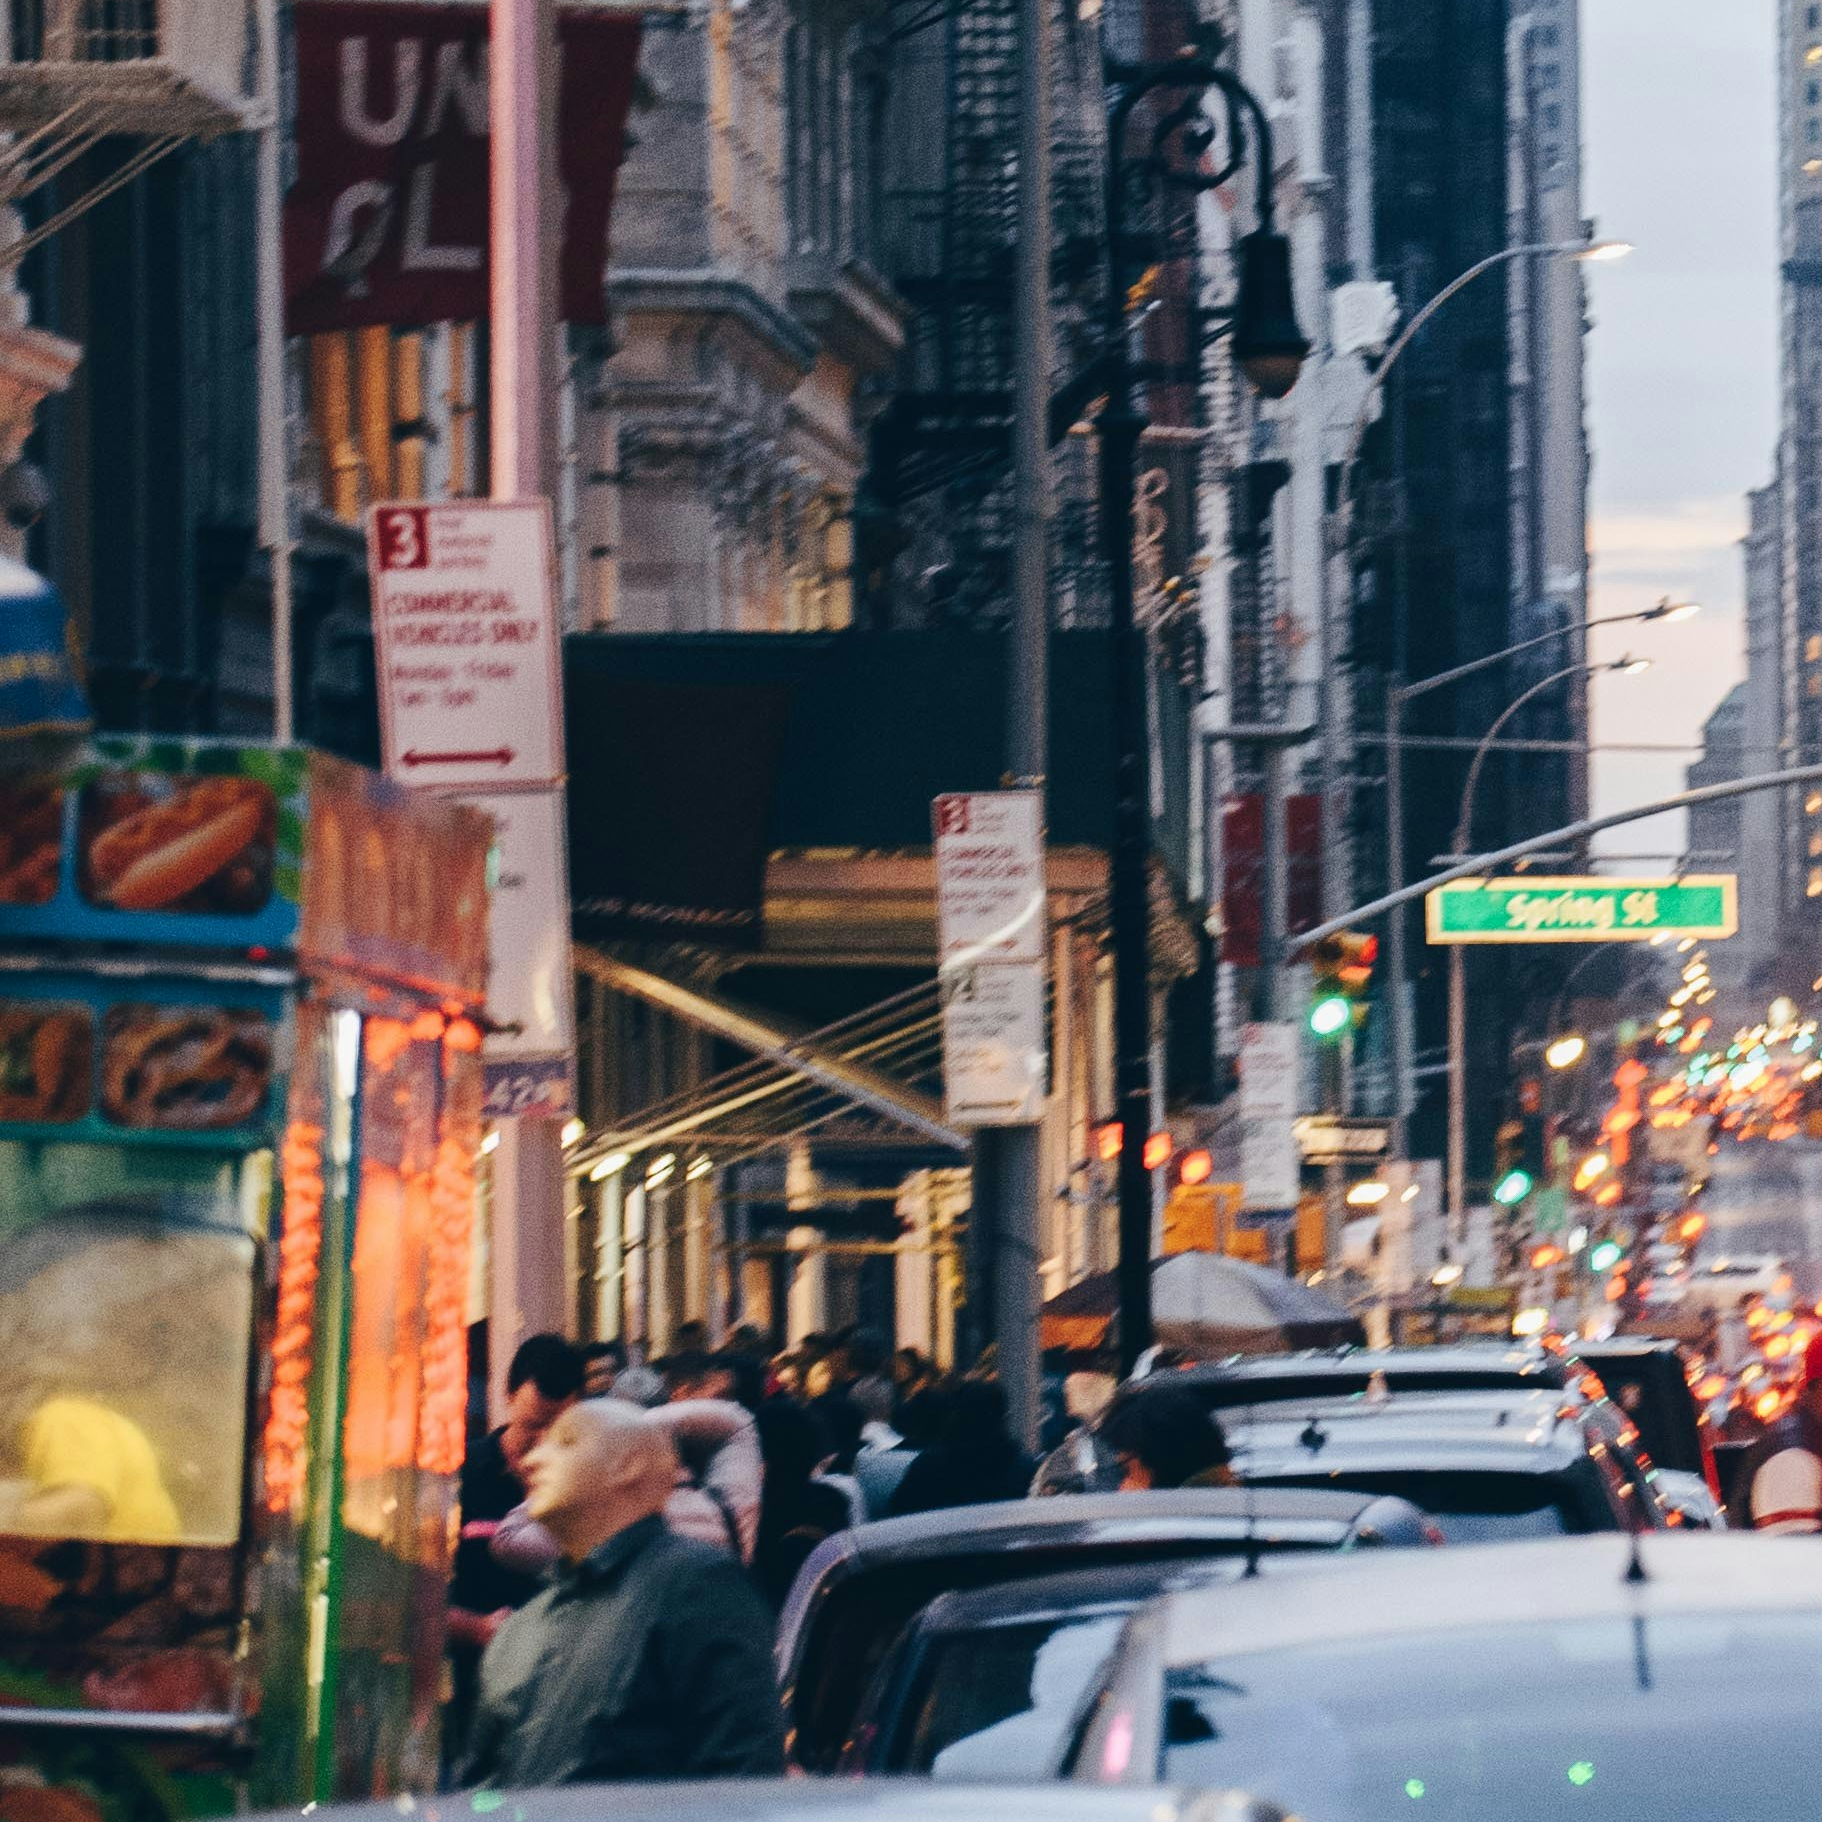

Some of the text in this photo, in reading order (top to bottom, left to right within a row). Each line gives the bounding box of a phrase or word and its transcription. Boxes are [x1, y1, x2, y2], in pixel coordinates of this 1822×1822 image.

[385, 511, 418, 567] 3
[1505, 889, 1662, 931] Spring St
